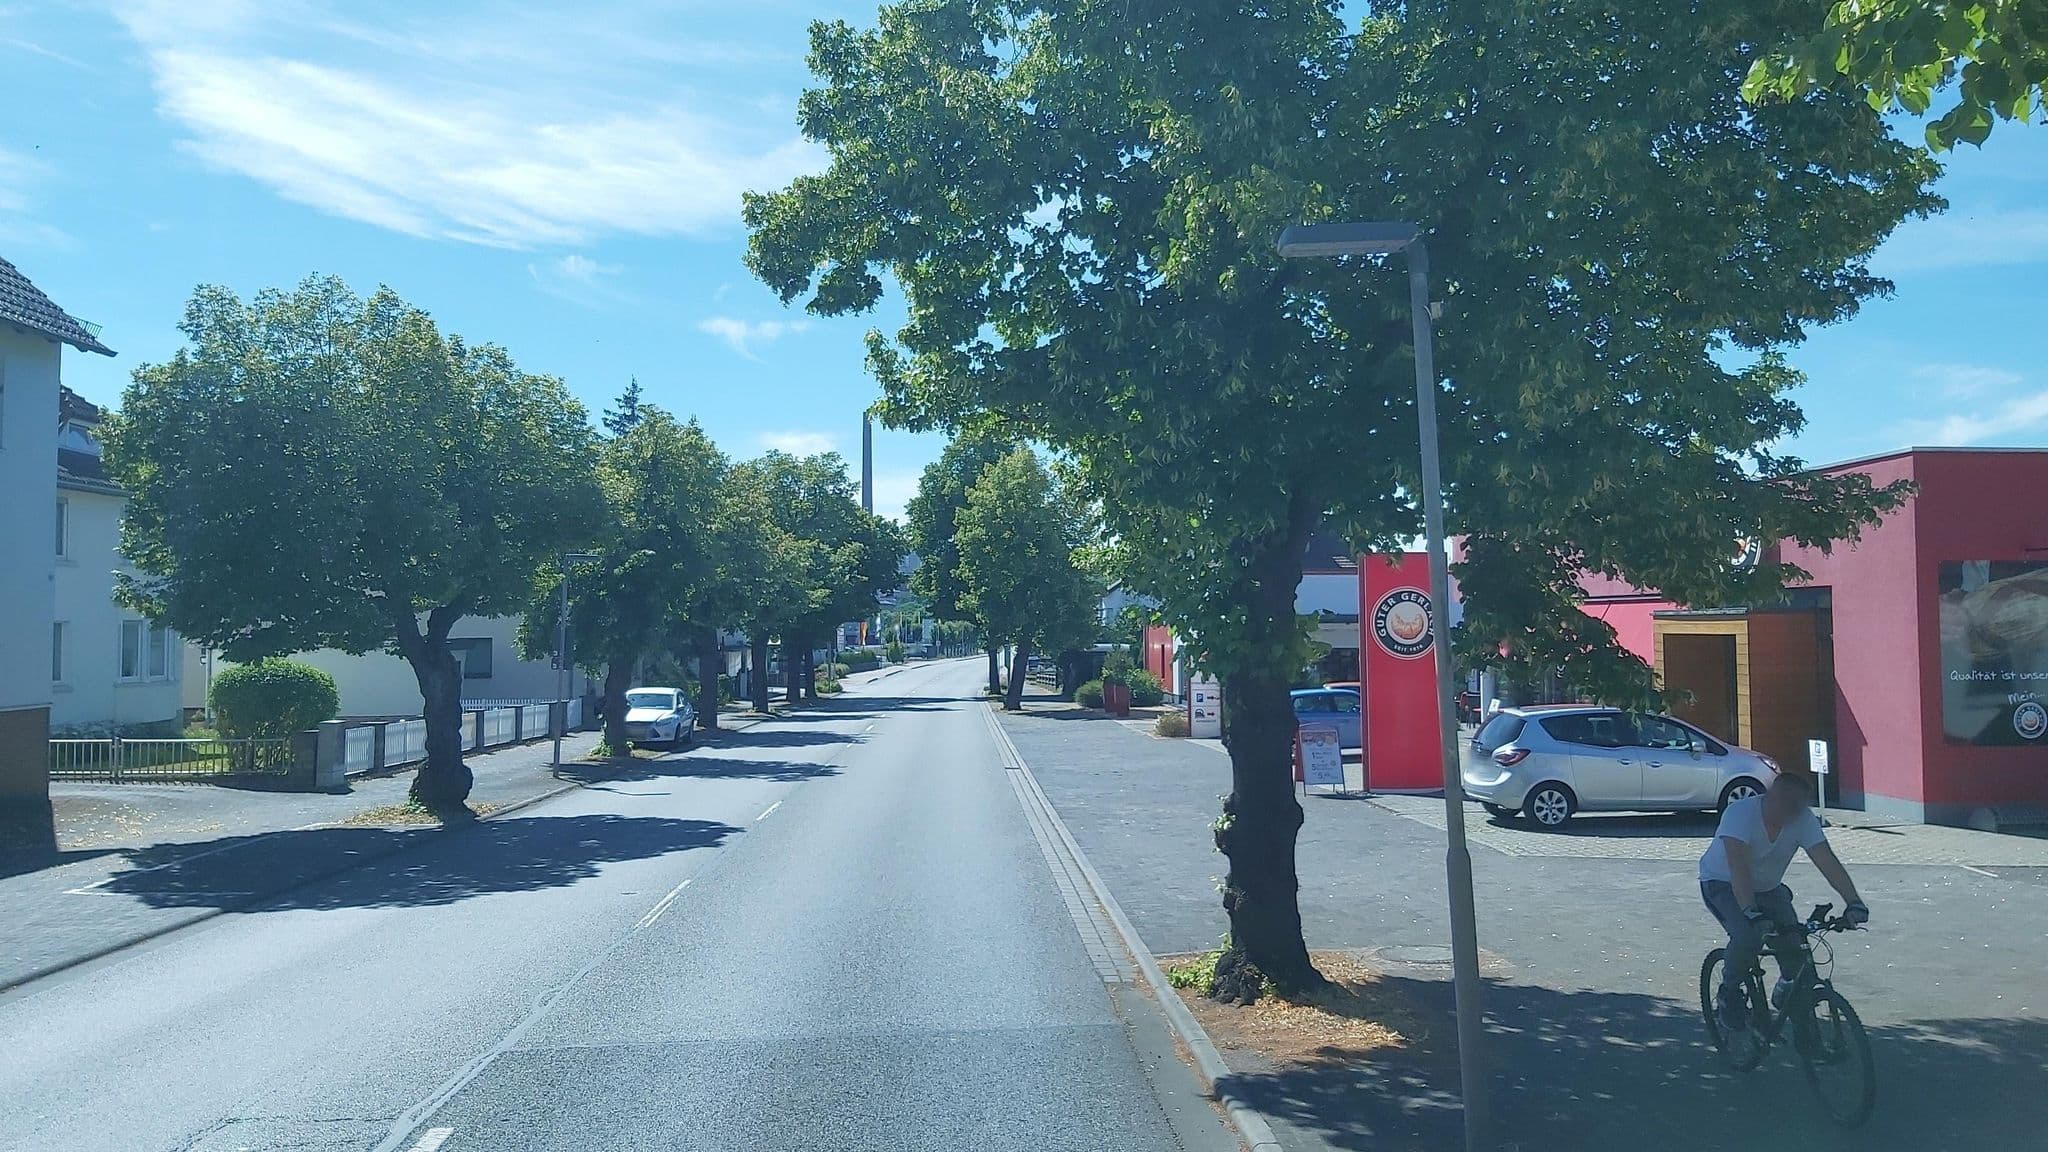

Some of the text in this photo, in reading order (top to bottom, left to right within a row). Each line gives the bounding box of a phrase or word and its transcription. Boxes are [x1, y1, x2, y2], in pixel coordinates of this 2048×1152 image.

[1376, 597, 1396, 637] GUTER
[1950, 670, 1997, 681] Qualität
[2000, 670, 2016, 681] ist
